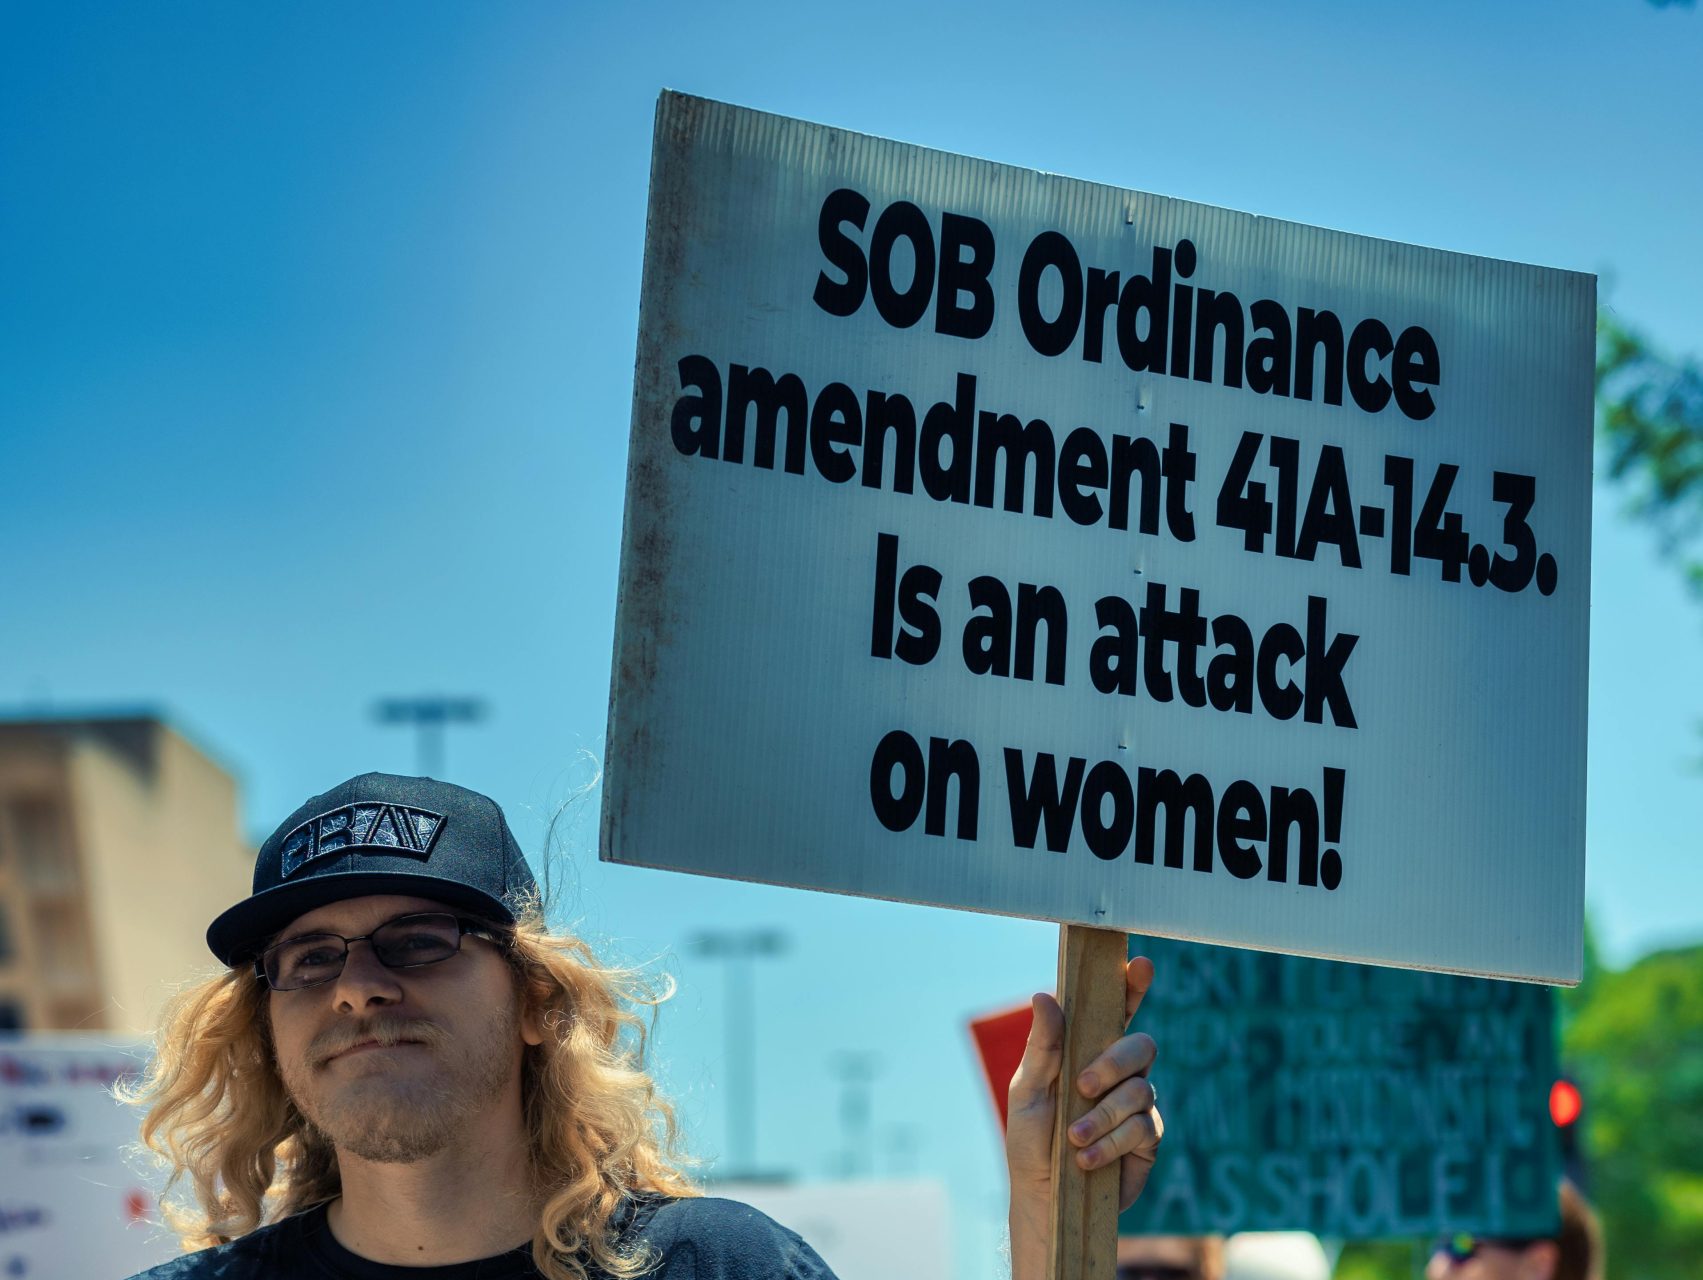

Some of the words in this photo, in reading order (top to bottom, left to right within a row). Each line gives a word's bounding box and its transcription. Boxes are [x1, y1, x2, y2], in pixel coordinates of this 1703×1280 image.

[813, 189, 995, 339] SOB
[1018, 231, 1440, 420] Ordinance
[671, 355, 1196, 542] amendment
[1217, 431, 1557, 596] 41A-14.3.
[871, 533, 942, 665] Is
[963, 576, 1067, 685] an
[1090, 582, 1359, 729] attack
[870, 730, 980, 841] on
[1004, 748, 1345, 890] women!
